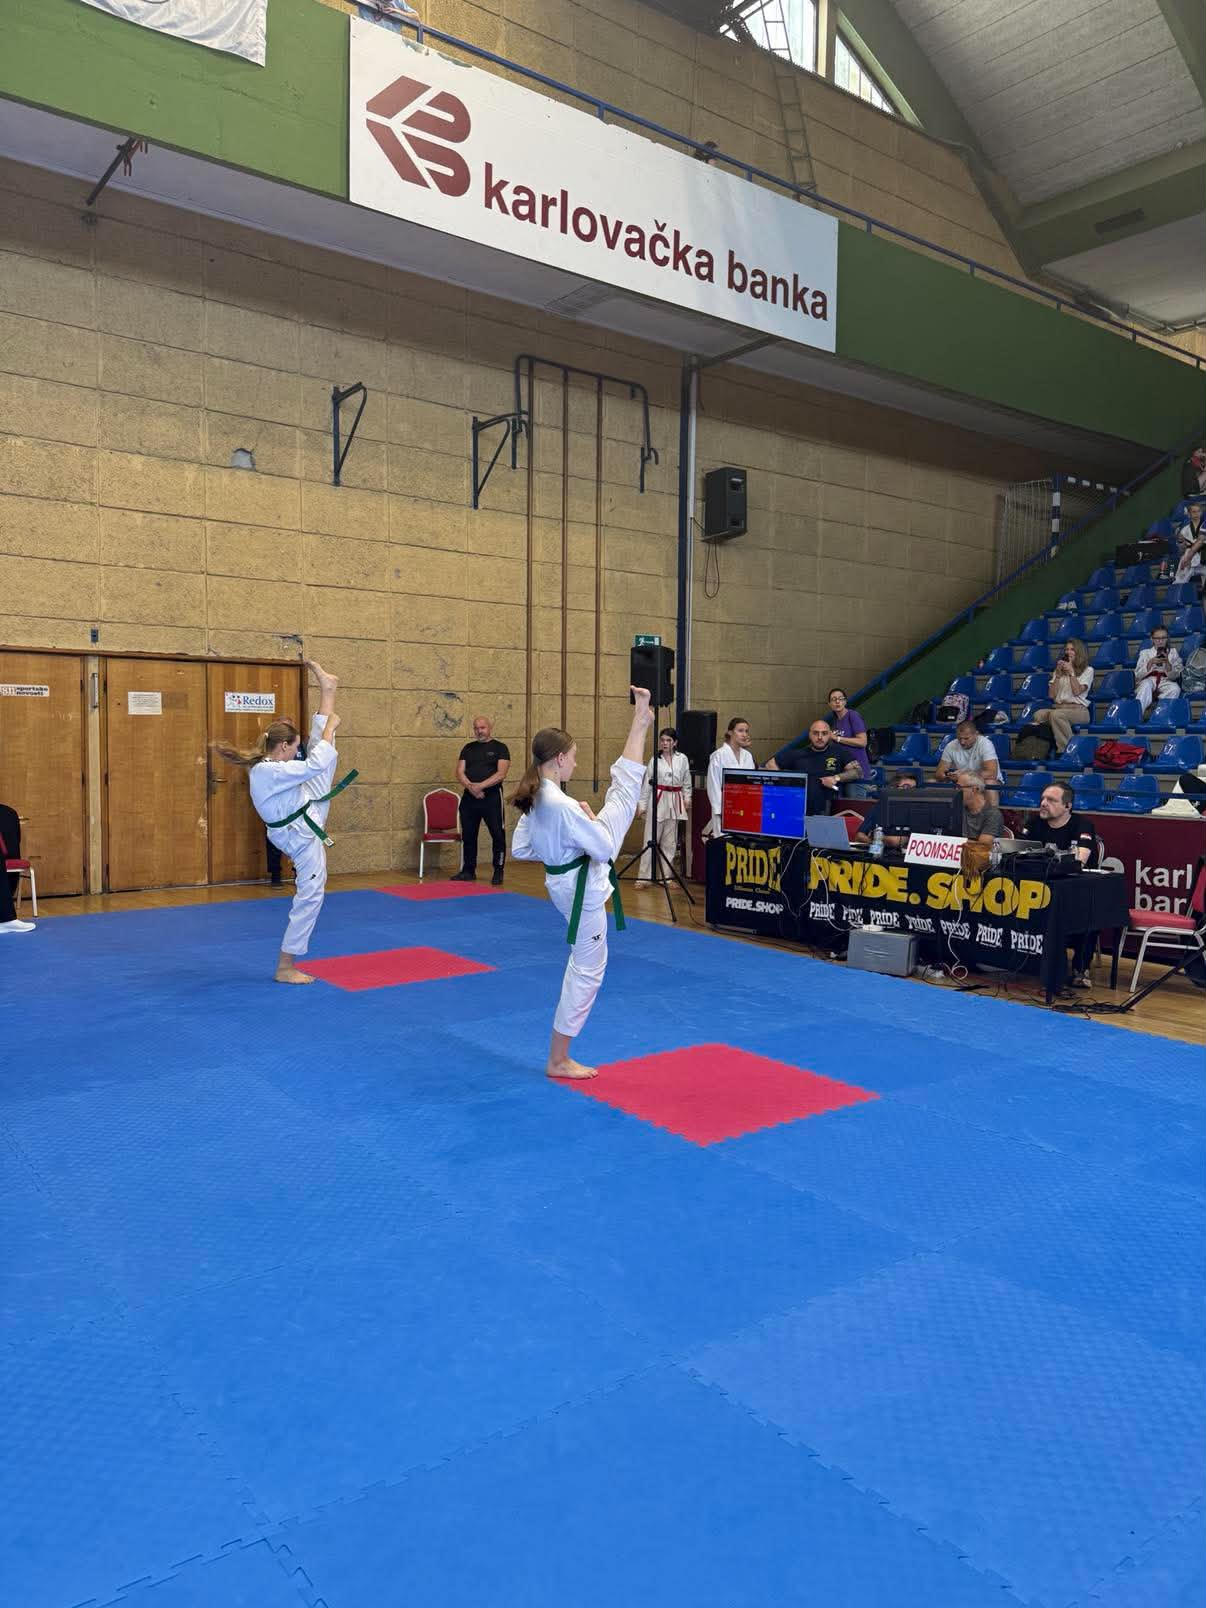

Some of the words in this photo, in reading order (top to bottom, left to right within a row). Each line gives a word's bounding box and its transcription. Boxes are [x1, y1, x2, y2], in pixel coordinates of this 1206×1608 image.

[485, 162, 714, 283] karlovačka
[728, 250, 828, 321] banka
[243, 695, 273, 706] Redox
[908, 839, 963, 862] POOMSAE
[725, 842, 782, 892] PRIDE
[1135, 859, 1193, 890] karl
[726, 896, 784, 915] PRIDE.SHOP
[809, 901, 836, 920] PRIDE
[870, 909, 901, 928] PRIDE
[905, 913, 936, 933] PRIDE
[940, 919, 971, 940] PRIDE
[976, 923, 1003, 948] PRIDE
[1010, 929, 1044, 955] PRIDE
